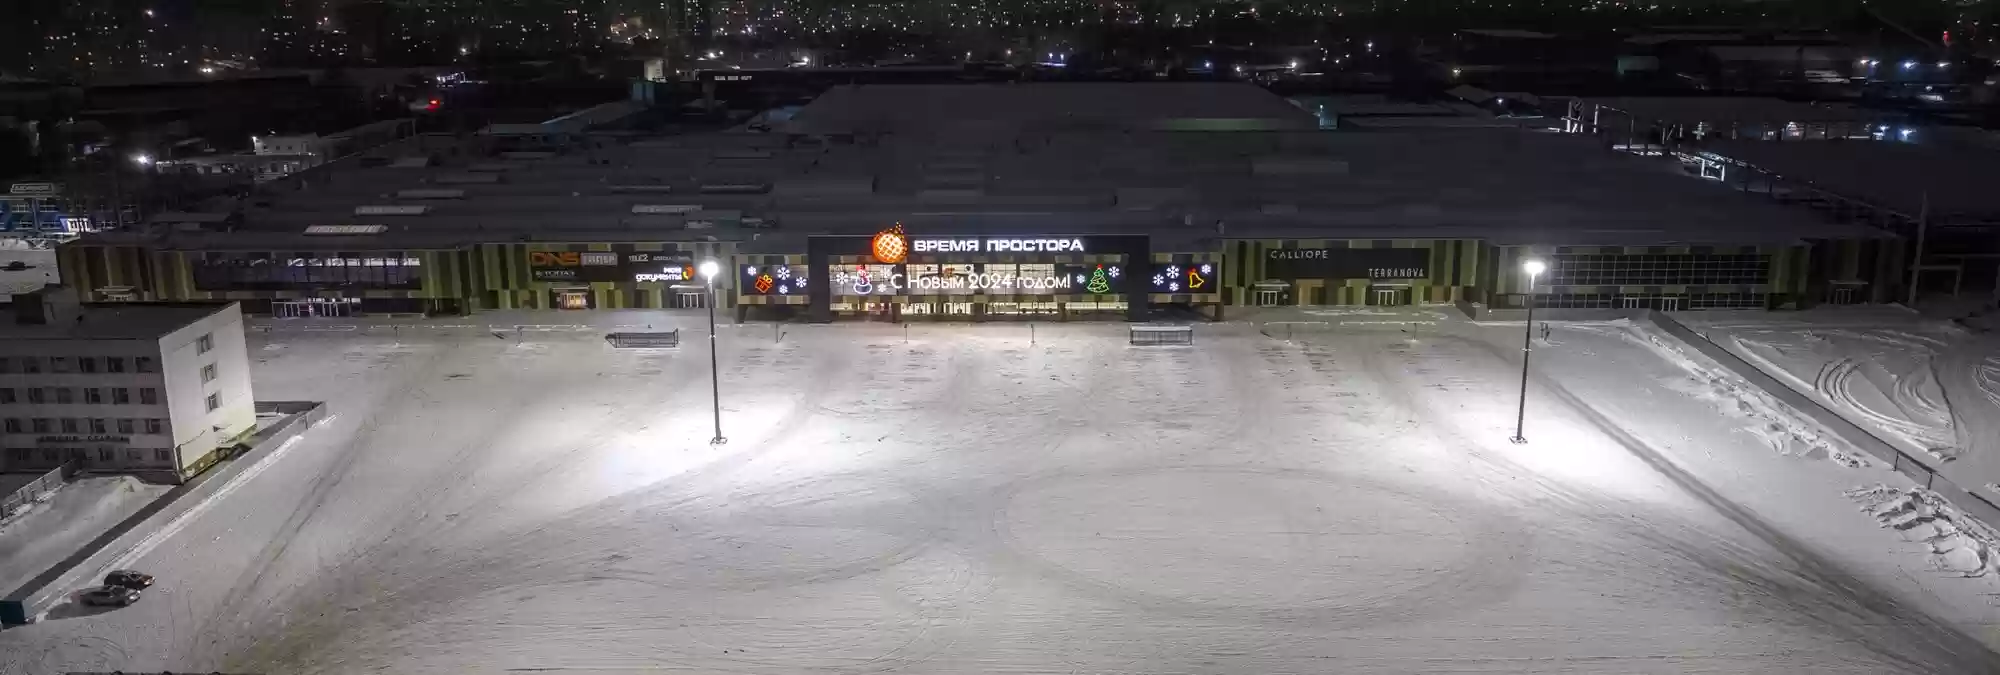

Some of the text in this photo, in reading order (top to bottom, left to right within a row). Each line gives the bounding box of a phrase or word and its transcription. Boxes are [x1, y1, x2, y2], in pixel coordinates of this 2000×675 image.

[914, 239, 1085, 252] ВРЕМЯ ПРОСТОРА
[531, 252, 579, 267] DNS
[1270, 250, 1329, 259] CALLIOPE
[1368, 268, 1424, 278] TERRANOVA
[890, 273, 903, 289] С
[968, 273, 1013, 289] 2024
